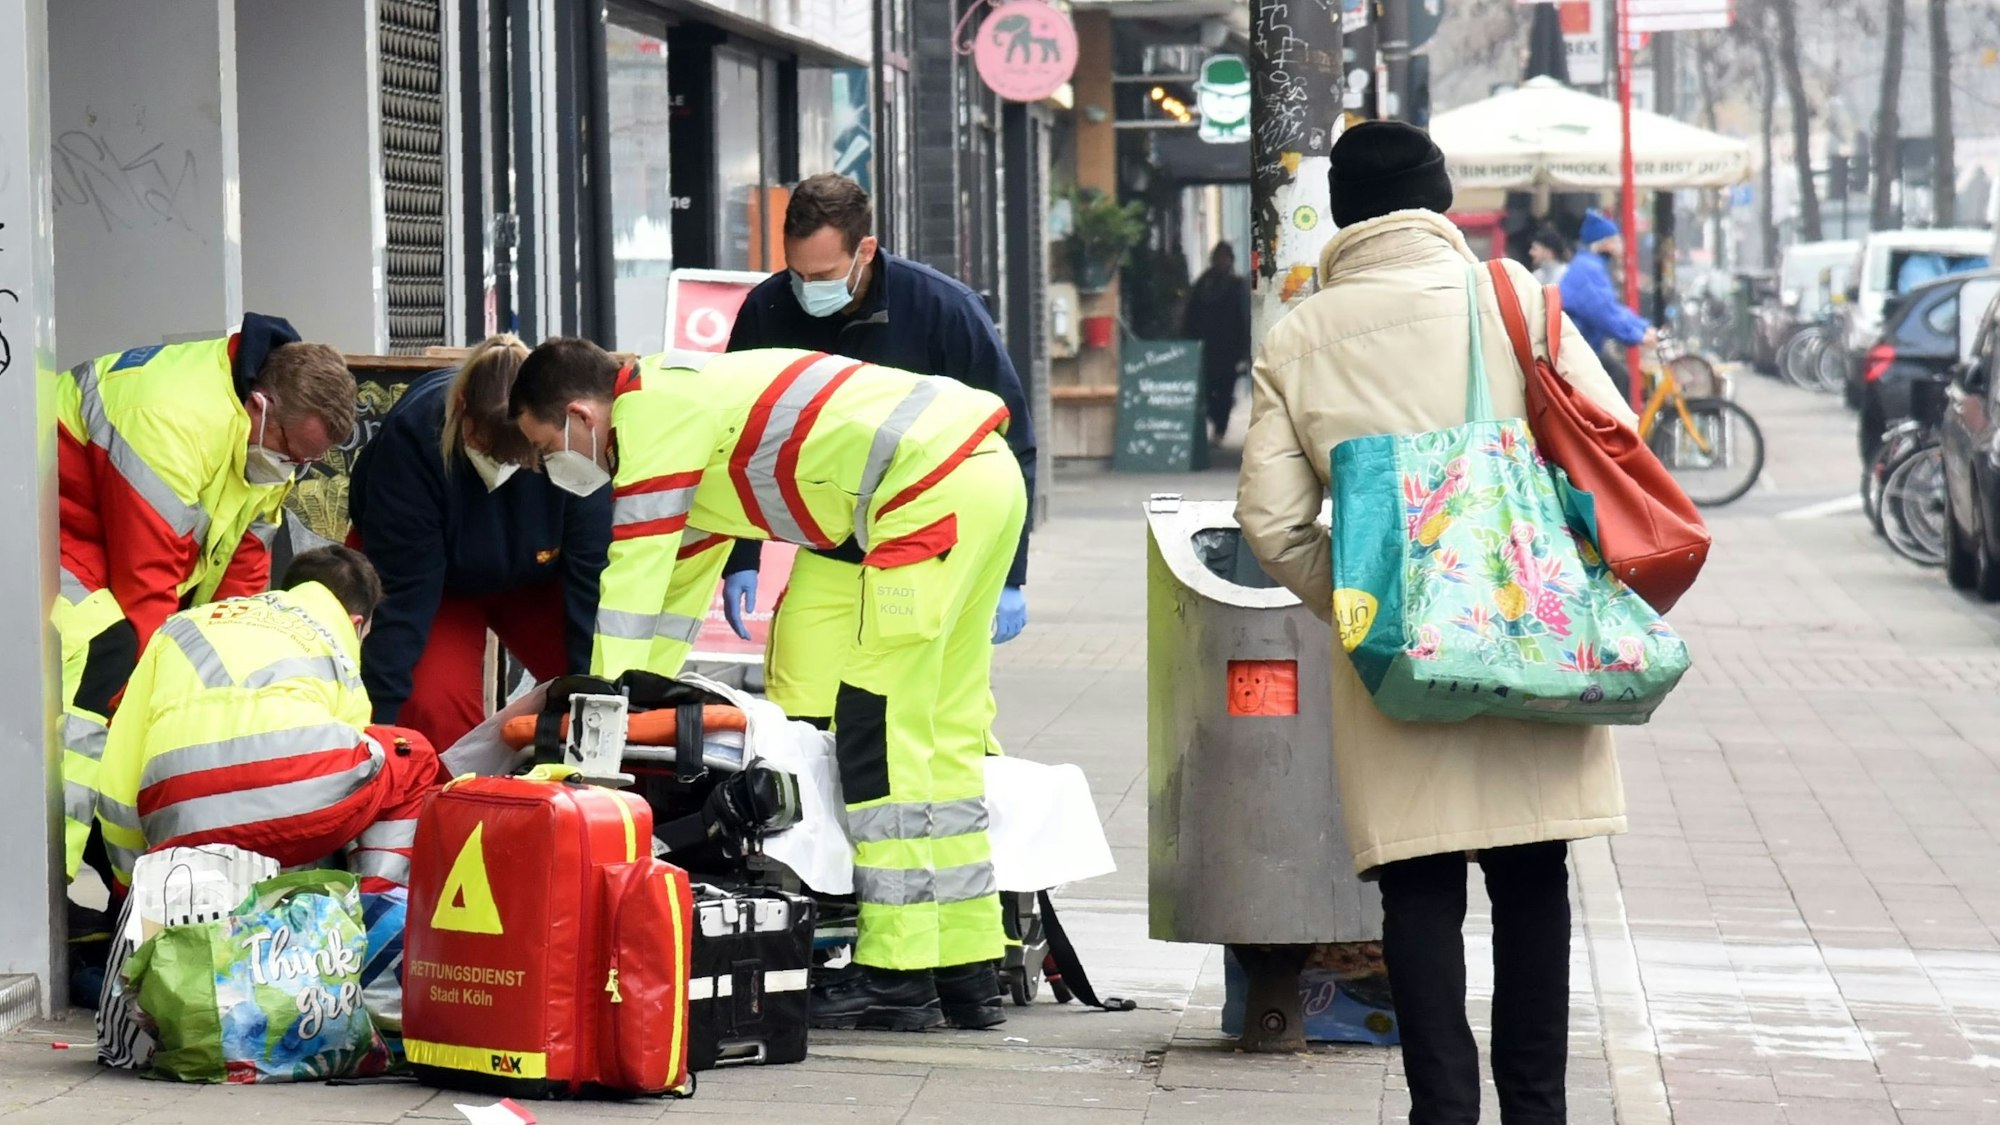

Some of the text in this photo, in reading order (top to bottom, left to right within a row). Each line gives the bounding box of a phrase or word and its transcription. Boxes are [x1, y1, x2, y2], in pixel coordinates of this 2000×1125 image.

[877, 585, 917, 599] STADT
[242, 925, 362, 985] Think
[410, 960, 526, 987] RETTUNGSDIENST
[430, 985, 493, 1007] Stadt Köln
